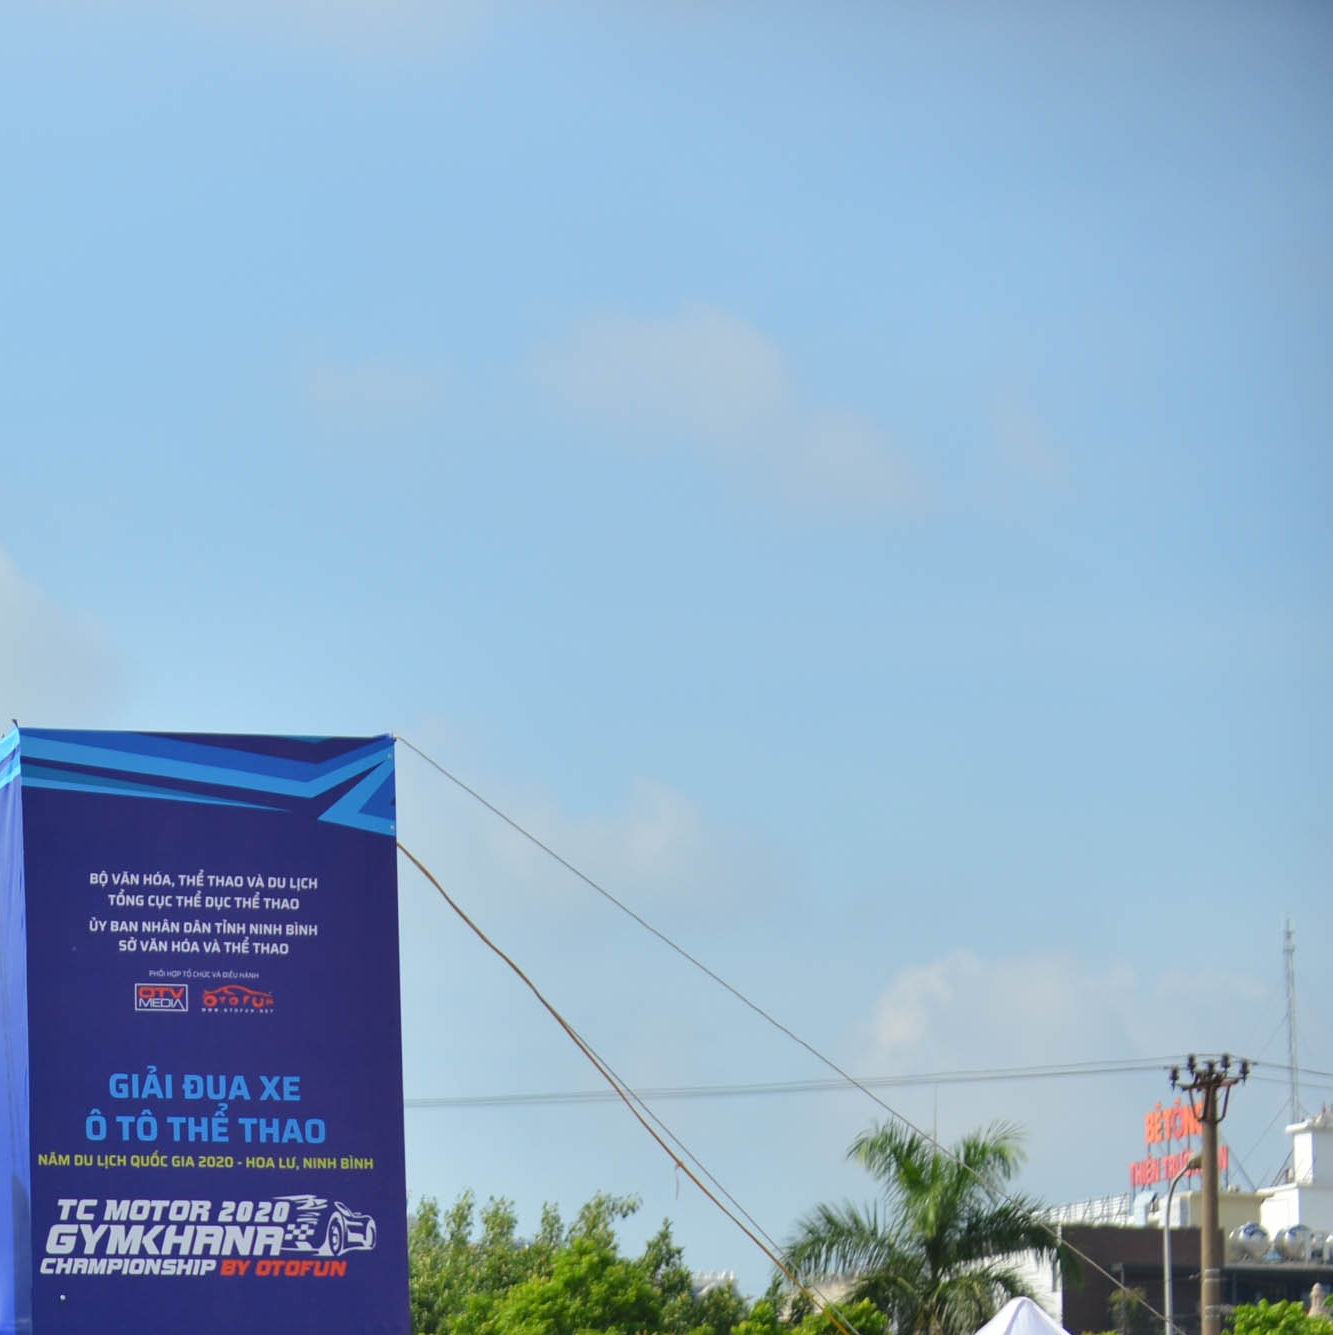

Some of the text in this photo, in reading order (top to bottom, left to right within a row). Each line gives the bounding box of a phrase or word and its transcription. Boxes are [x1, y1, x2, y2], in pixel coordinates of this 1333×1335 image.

[89, 868, 318, 892] BỘ VĂN HÓA, THỂ THAO VÀ DU LỊCH
[107, 891, 300, 911] TỔNG CỤC THỂ DỤC THỂ THAO
[109, 920, 139, 933] BAN
[141, 918, 180, 934] NHÂN
[183, 919, 212, 934] DÂN
[214, 919, 246, 935] TỈNH
[249, 923, 283, 936] NINH
[285, 921, 318, 937] BÌNH
[118, 936, 289, 955] SỞ VĂN HÓA VÀ THỂ THAO
[108, 1064, 301, 1102] GIẢI ĐUA XE
[85, 1101, 326, 1145] Ô TÔ THỂ THAO
[37, 1150, 375, 1170] NĂM DU LỊCH QUỐC GIA 2020 HOA LƯ, NINH BÌNH
[57, 1198, 291, 1224] TC MOTOR 2020
[45, 1223, 284, 1257] GYMKHANA
[39, 1257, 348, 1277] CHAMPIONSHIP BY OTOFUN
